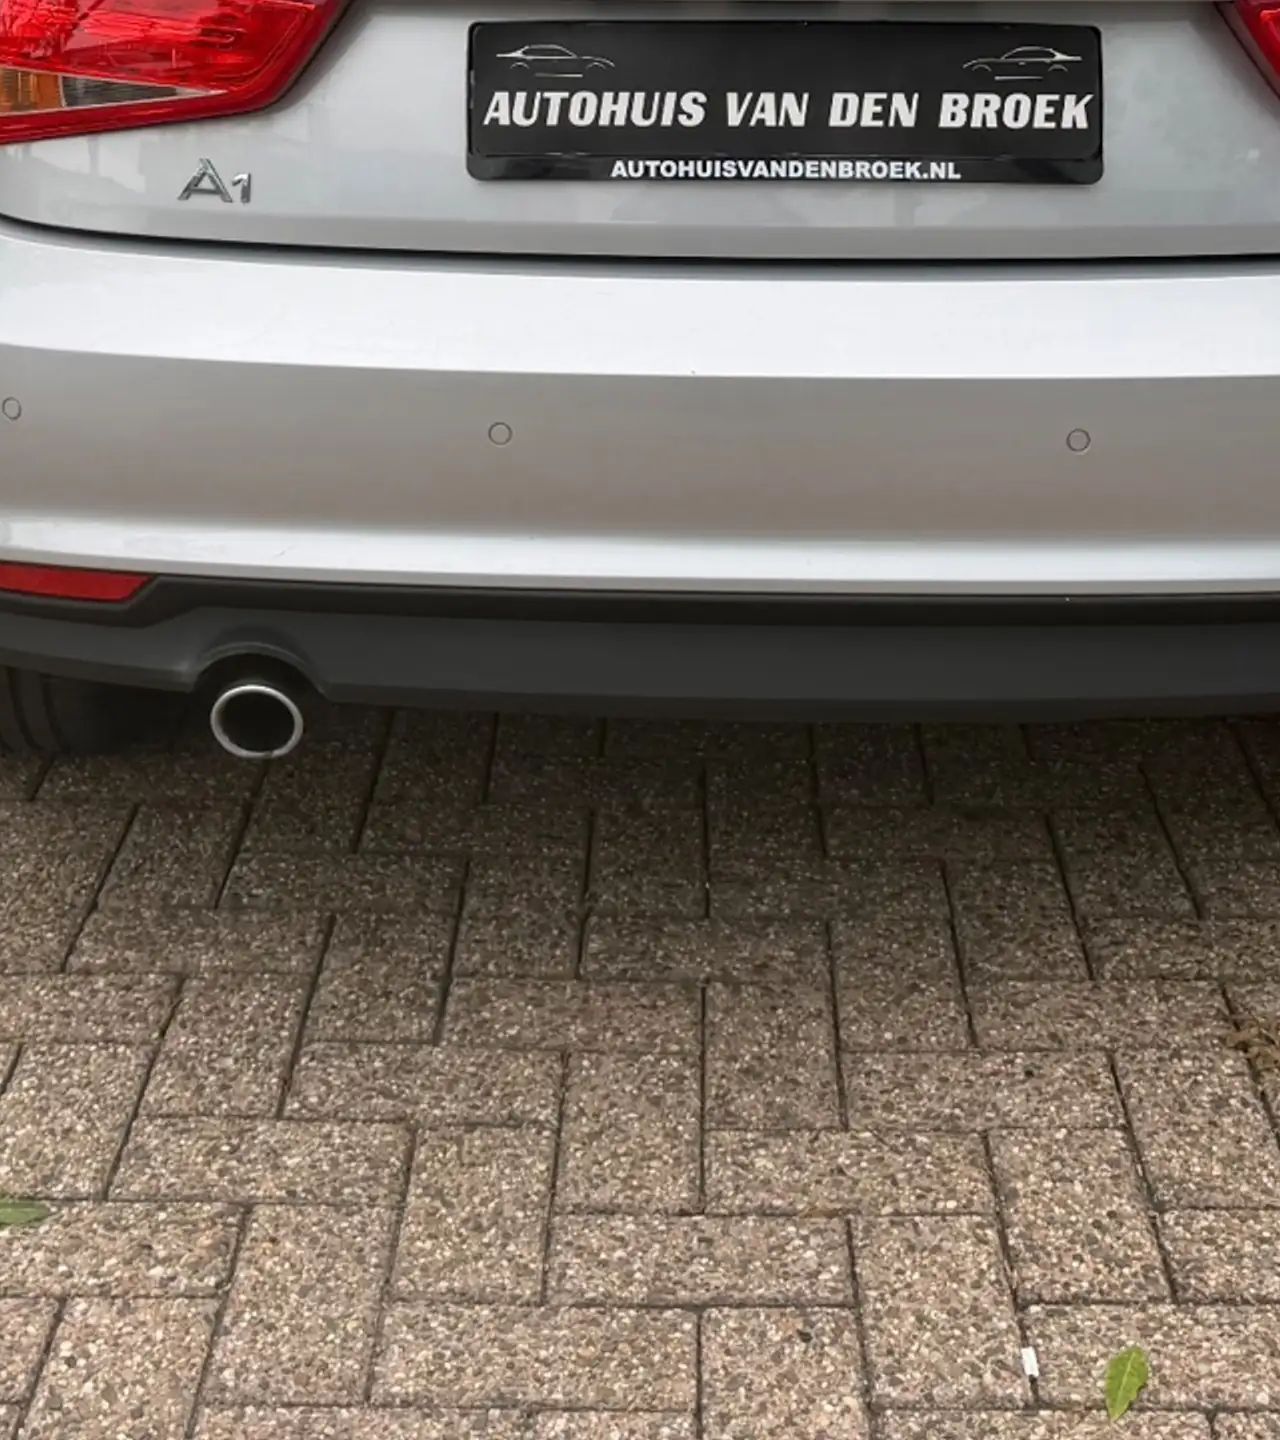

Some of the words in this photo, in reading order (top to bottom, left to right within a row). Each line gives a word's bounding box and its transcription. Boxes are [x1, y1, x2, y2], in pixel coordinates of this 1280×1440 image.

[483, 91, 709, 129] AUTOHUIS
[725, 92, 811, 128] VAN
[828, 92, 921, 129] DEN
[938, 92, 1094, 131] BROEK
[176, 157, 252, 204] A1
[610, 159, 963, 181] AUTOHUISVANDENBROEK.NL
